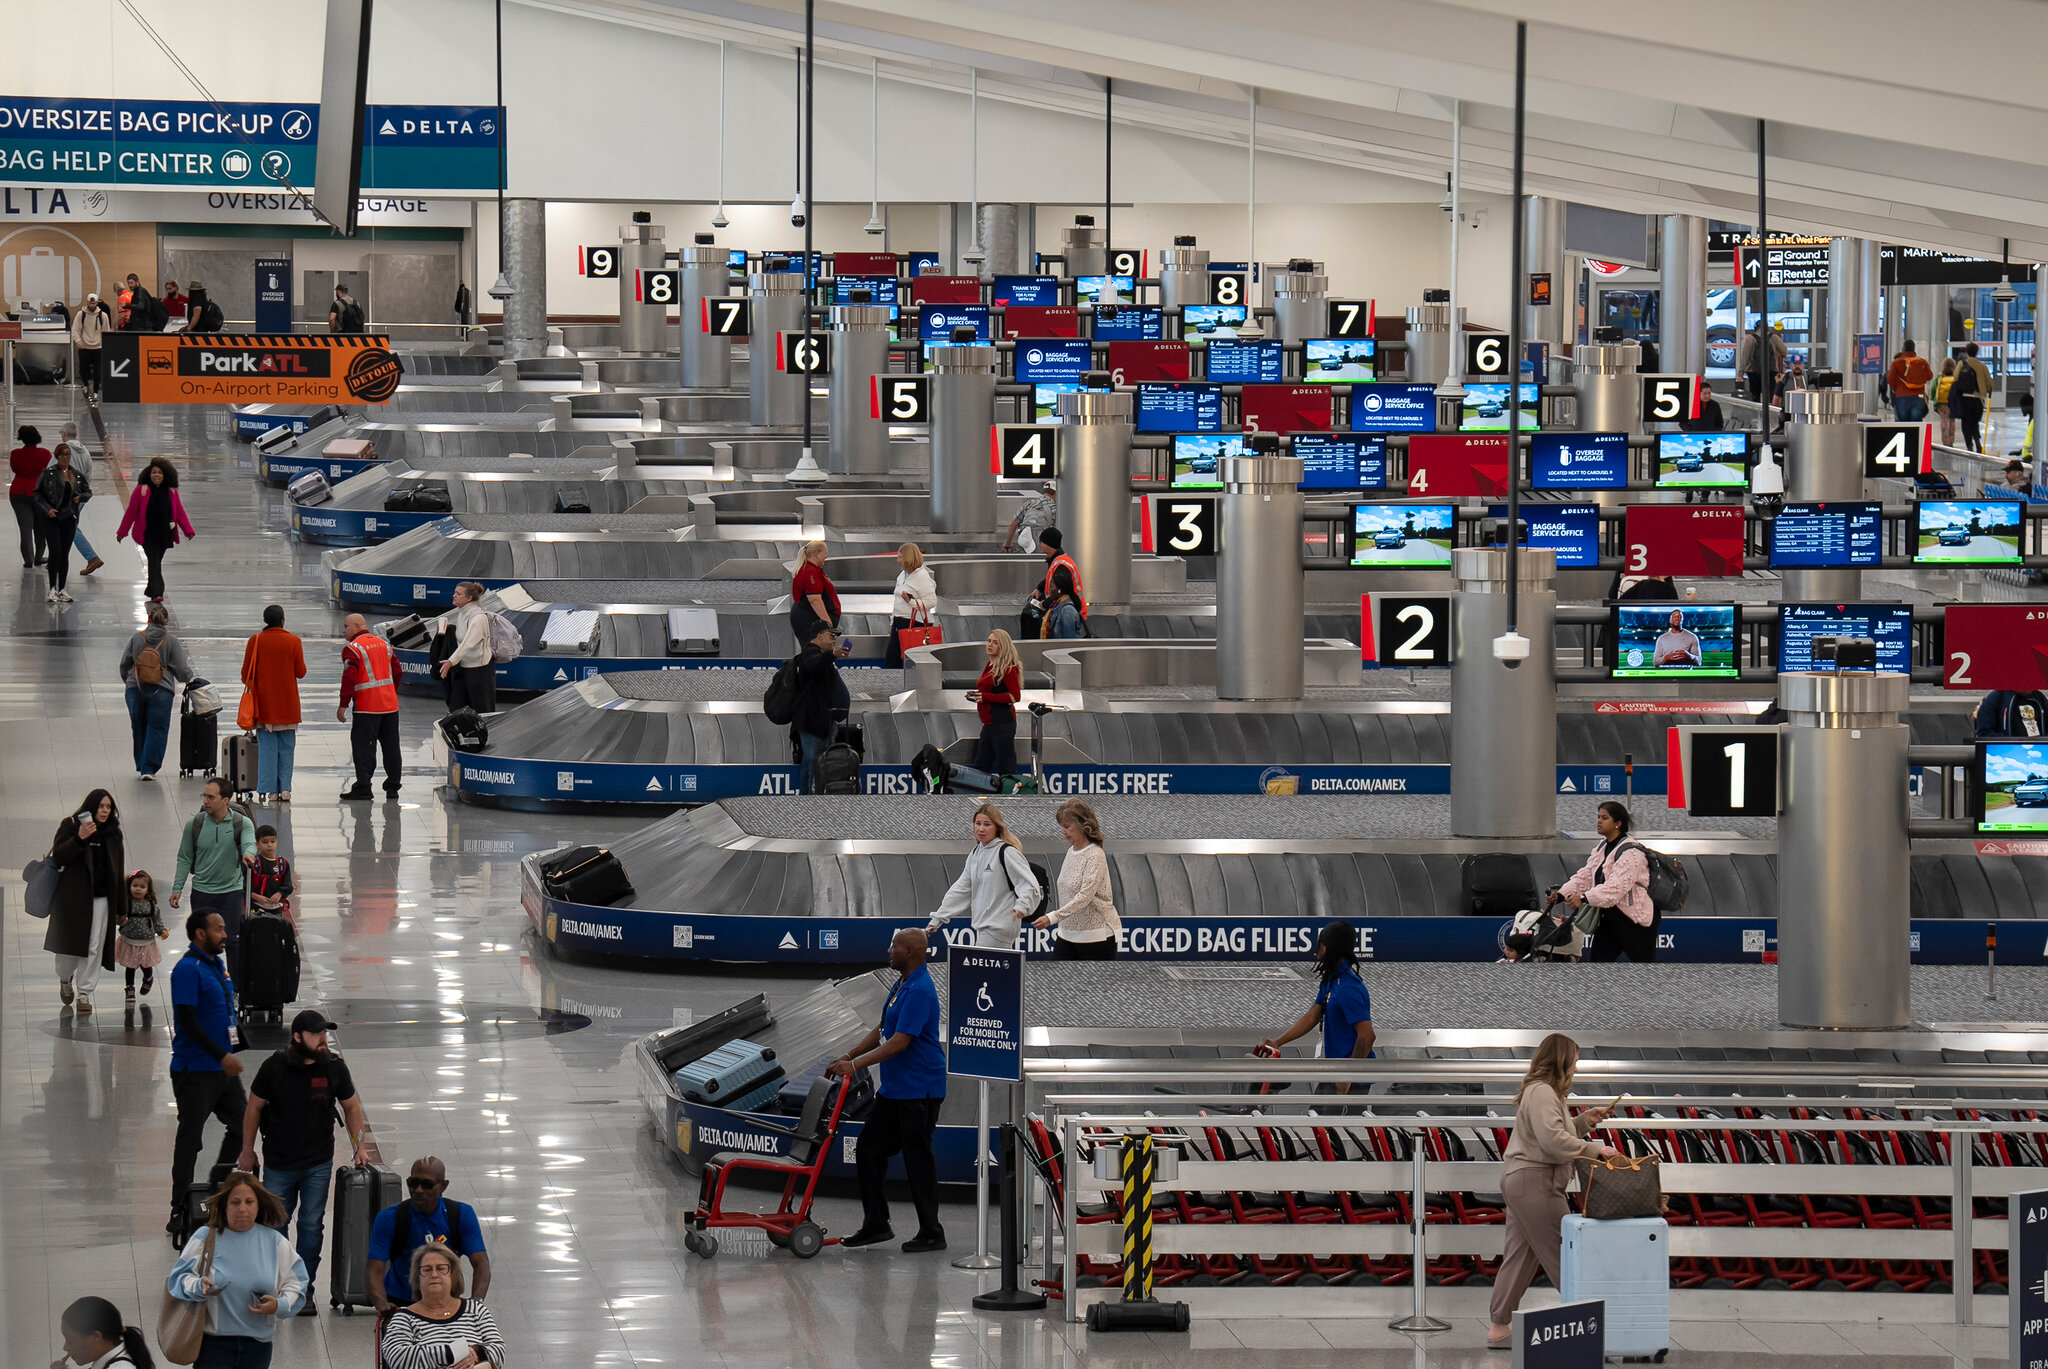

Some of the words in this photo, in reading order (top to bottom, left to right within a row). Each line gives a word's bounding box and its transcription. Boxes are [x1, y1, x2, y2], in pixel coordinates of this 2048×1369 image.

[0, 108, 112, 130] OVERSIZE
[120, 111, 170, 132] BAG
[178, 112, 273, 134] PICK-UP
[403, 120, 473, 134] DELTA
[0, 149, 44, 170] BAG
[53, 150, 111, 171] HELP
[118, 152, 213, 174] CENTER
[592, 250, 613, 276] 9
[1115, 253, 1135, 277] 9
[1784, 251, 1818, 260] Ground
[1784, 269, 1816, 279] Rental
[650, 274, 672, 302] 8
[1217, 277, 1238, 305] 8
[717, 303, 741, 333] 7
[1337, 304, 1360, 335] 7
[793, 338, 821, 372] 6
[1475, 338, 1502, 372] 6
[351, 361, 398, 389] DETOUR
[1112, 368, 1125, 387] 6
[180, 381, 272, 398] On-Airport
[277, 382, 339, 398] Parking
[891, 382, 919, 419] 5
[1653, 381, 1681, 419] 5
[1245, 415, 1259, 433] 5
[1012, 433, 1046, 474] 4
[1875, 432, 1910, 473] 4
[1410, 469, 1429, 492] 4
[302, 516, 336, 527] DELTA.COM/AMEX
[1169, 504, 1203, 551] 3
[1629, 544, 1648, 571] 3
[342, 582, 382, 595] DELTA.COM/AMEX
[1784, 607, 1791, 615] 2
[1394, 605, 1435, 660] 2
[1949, 652, 1972, 684] 2
[464, 767, 515, 785] DELTA.COM/AMEX
[759, 774, 800, 796] ATL,
[866, 774, 917, 794] FIRST
[1067, 773, 1118, 794] FLIES
[1311, 778, 1406, 792] DELTA.COM/AMEX
[1723, 742, 1746, 808] 1
[562, 918, 623, 940] DELTA.COM/AMEX
[1117, 927, 1192, 953] ECKED
[1197, 928, 1246, 953] BAG
[1252, 928, 1312, 953] FLIES
[972, 958, 1001, 968] DELTA
[960, 1027, 974, 1036] FOR
[975, 1028, 1010, 1040] MOBILITY
[967, 1017, 1003, 1029] RESERVED
[952, 1036, 996, 1049] ASSISTANCE
[997, 1040, 1017, 1051] ONLY
[699, 1126, 779, 1153] DELTA.COM/AMEX
[1544, 1321, 1585, 1342] DELTA
[2024, 1321, 2040, 1336] APP
